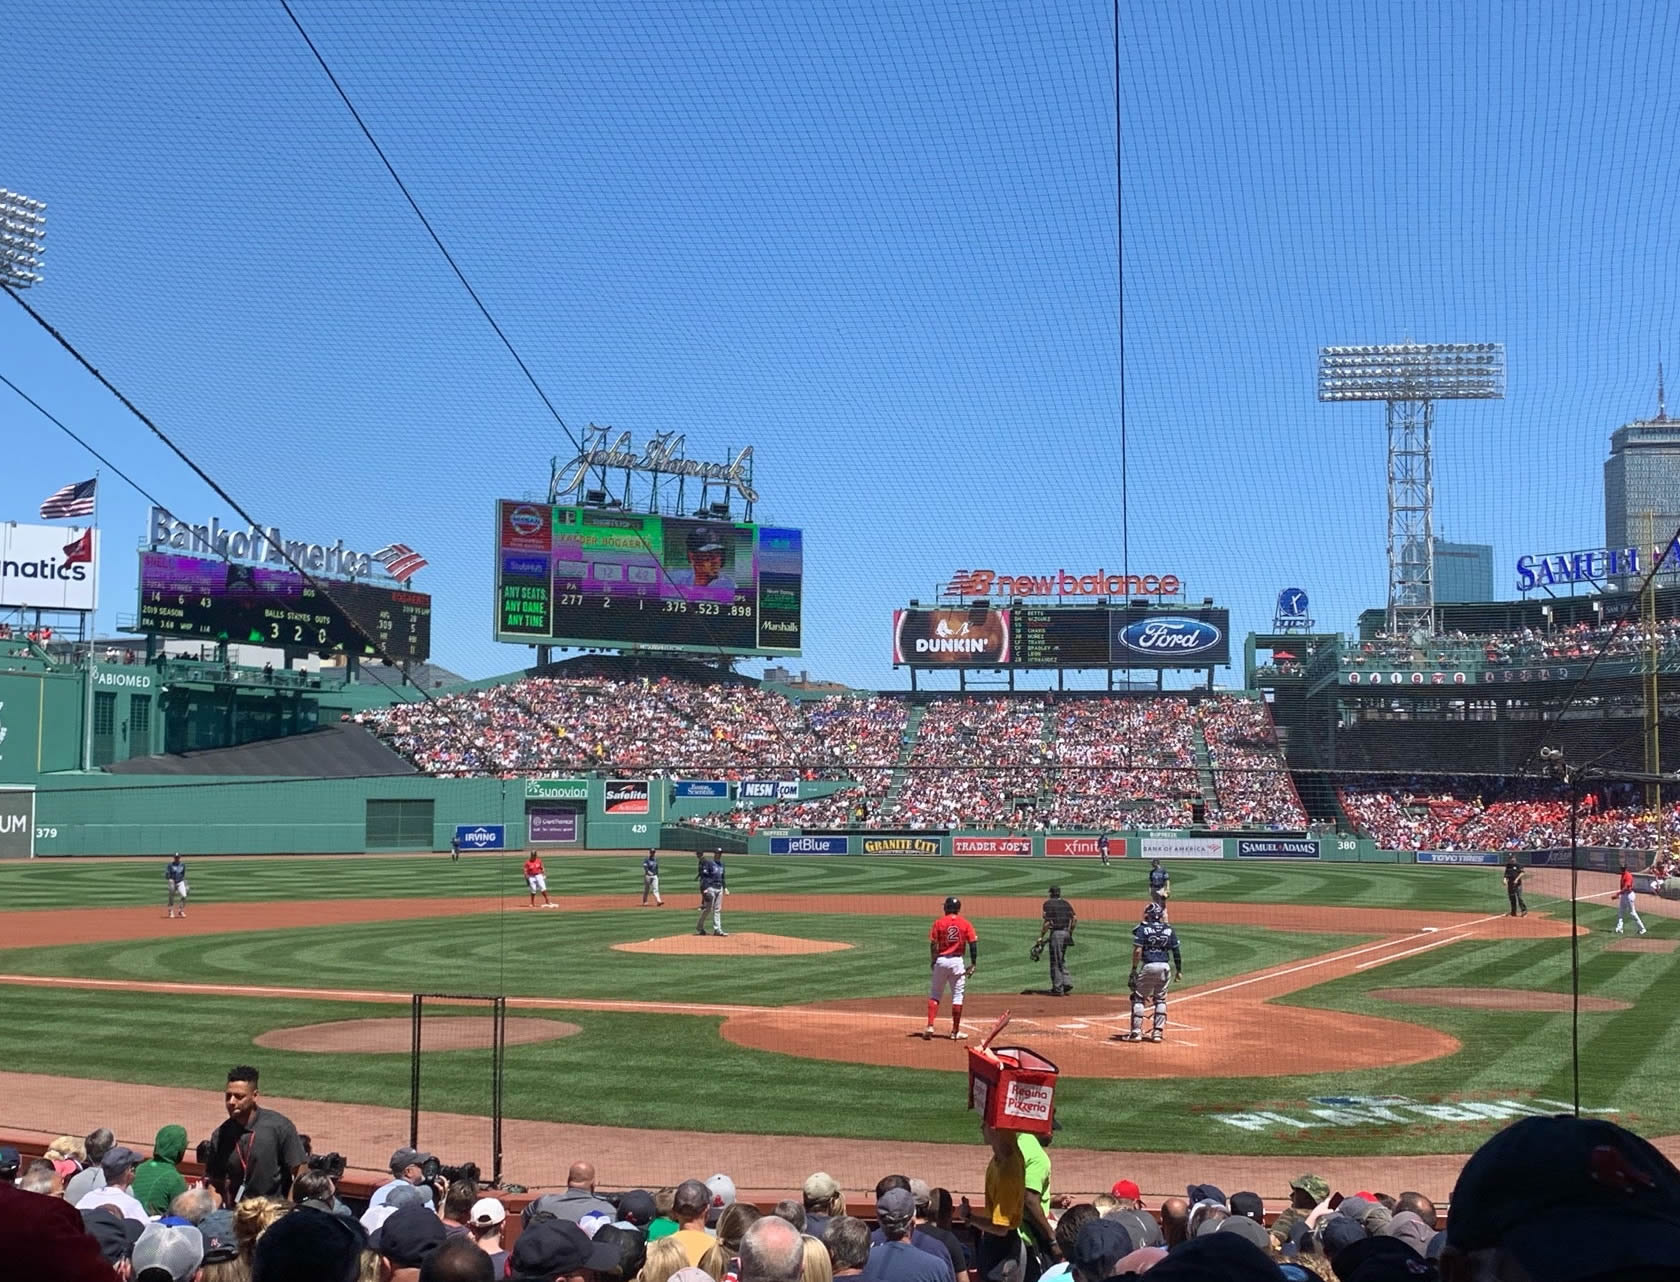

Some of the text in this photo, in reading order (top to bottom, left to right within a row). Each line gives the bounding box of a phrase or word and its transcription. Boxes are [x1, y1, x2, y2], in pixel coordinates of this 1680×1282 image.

[147, 505, 230, 556] Bank
[260, 527, 373, 578] America
[997, 575, 1056, 597] new
[1058, 568, 1180, 596] balance
[561, 594, 583, 606] 277
[603, 597, 611, 608] 2
[271, 623, 327, 644] 3 2 0
[1138, 622, 1201, 648] Ford
[916, 637, 989, 653] DUNKIN'
[98, 672, 151, 688] ABIOMED
[538, 786, 587, 797] sunovion
[606, 790, 647, 800] Safelite
[745, 783, 774, 797] NESN
[36, 828, 57, 838] 379
[631, 825, 647, 833] 420
[465, 832, 496, 842] IRVING
[788, 838, 830, 852] jetBlue
[865, 839, 912, 853] GRANITE
[914, 839, 939, 854] CITY
[956, 841, 1030, 852] TRADER JOE'S
[1242, 842, 1316, 853] SAMUEL ADAMS
[1337, 841, 1357, 850] 380
[947, 925, 960, 942] 2
[1011, 1084, 1048, 1100] Regina
[1008, 1097, 1047, 1114] Pizzeria
